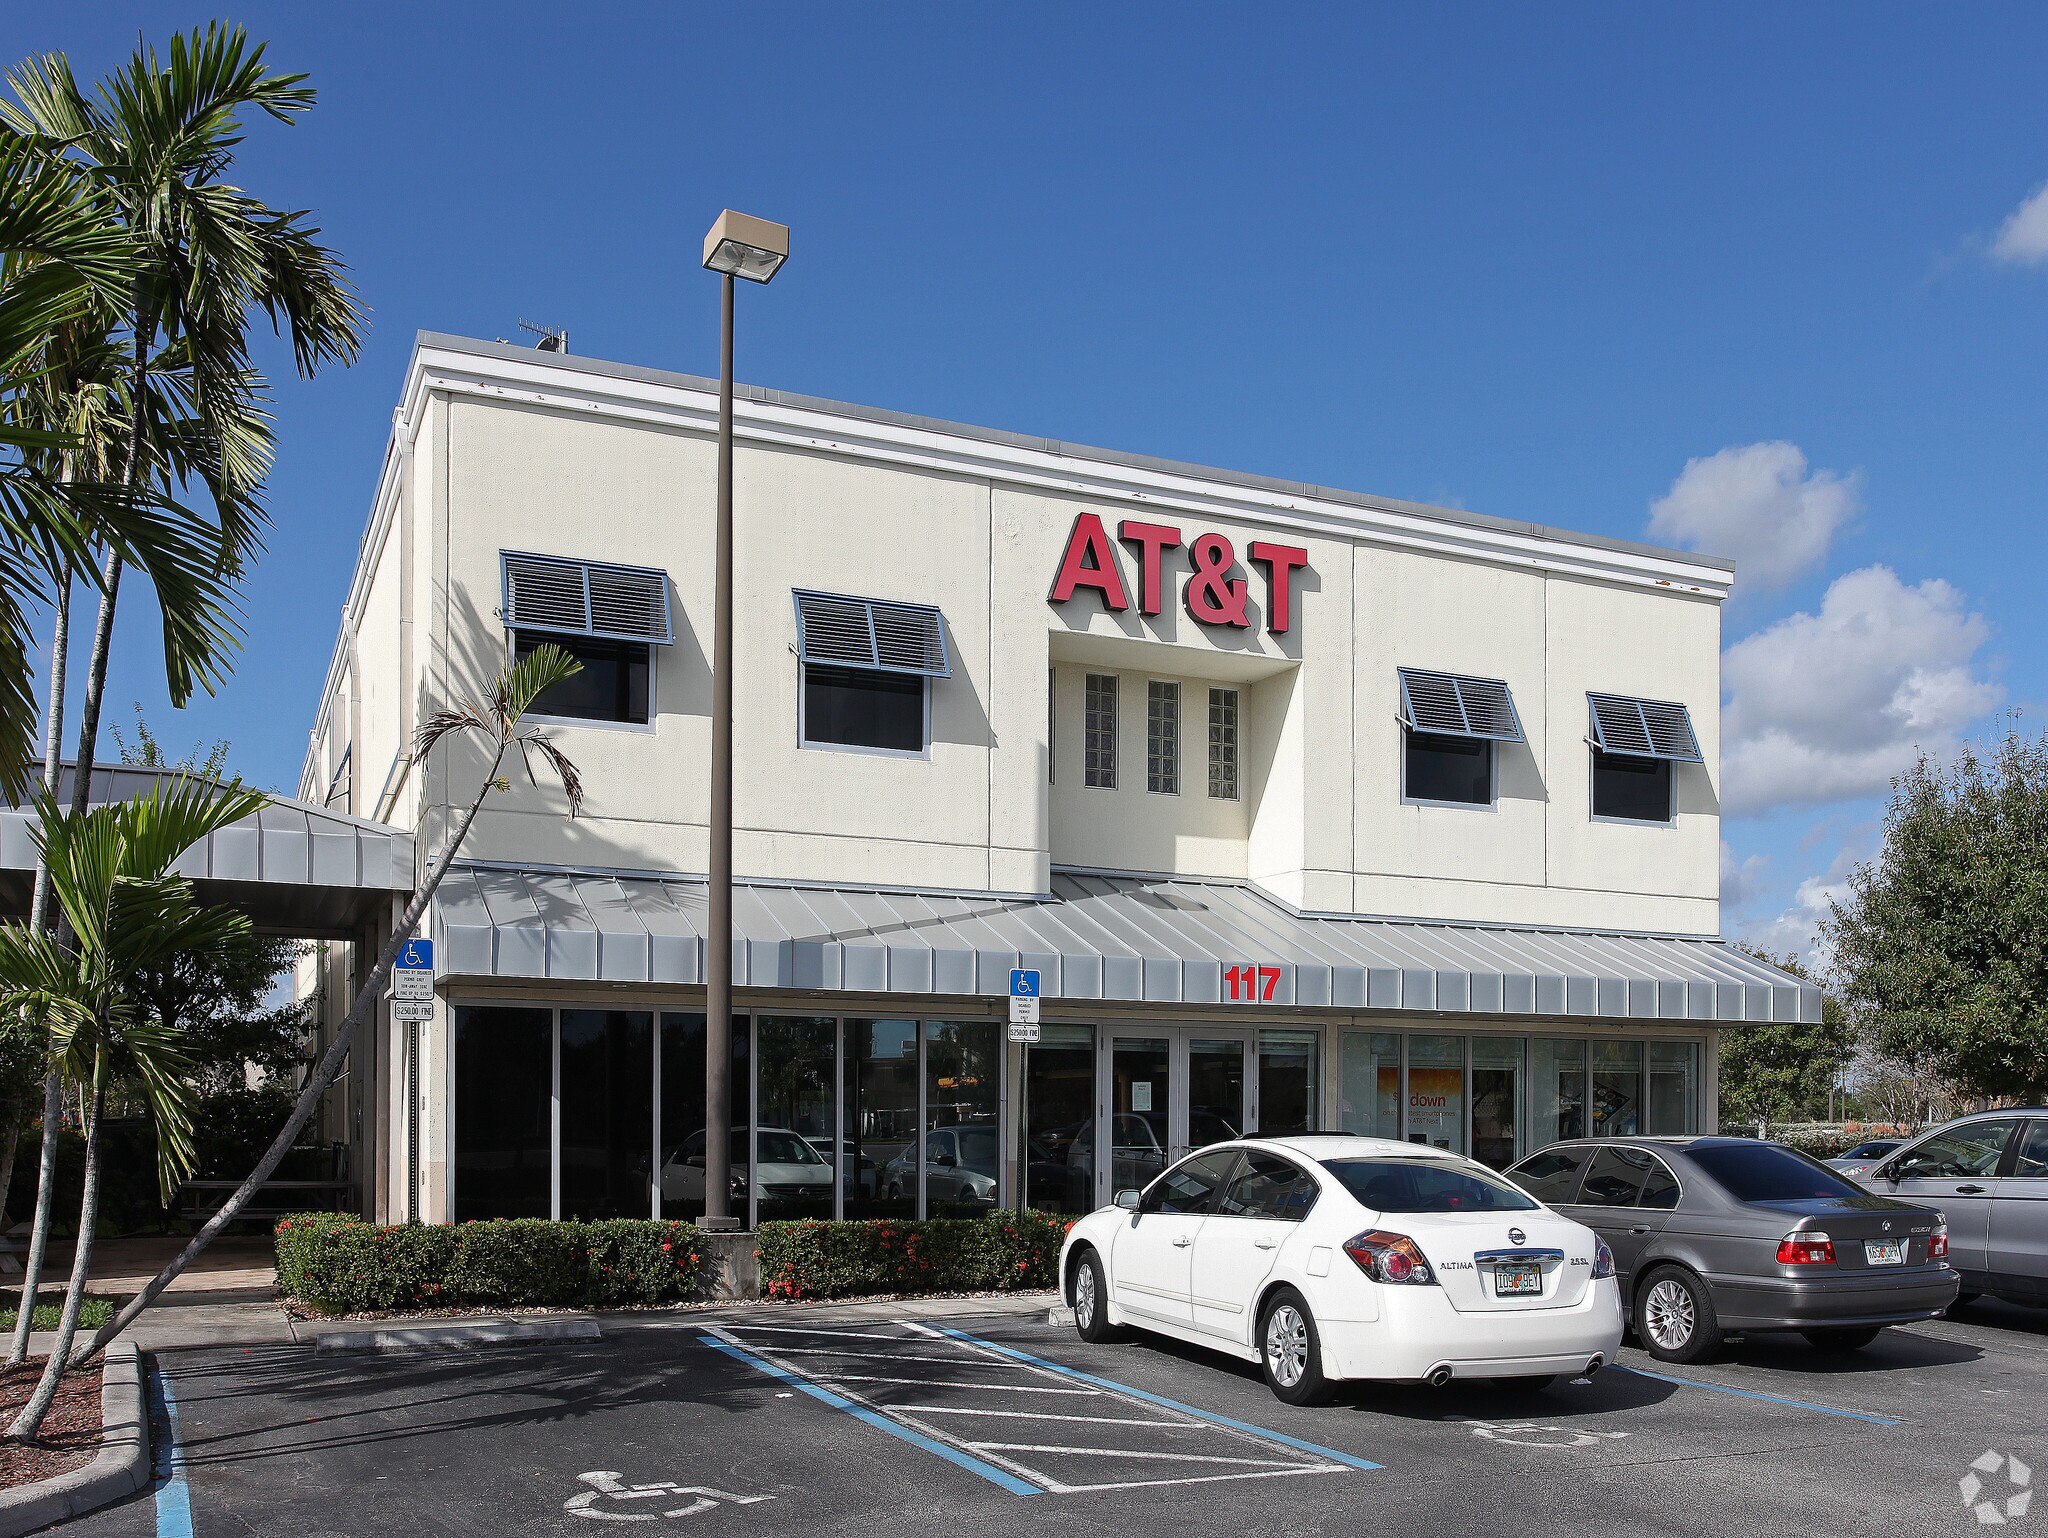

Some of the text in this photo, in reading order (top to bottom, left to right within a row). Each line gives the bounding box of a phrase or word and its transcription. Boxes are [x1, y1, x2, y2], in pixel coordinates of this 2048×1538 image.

[1048, 512, 1307, 634] AT&T
[1224, 965, 1281, 1001] 117
[397, 1006, 431, 1015] $250.00 FINE
[1410, 1091, 1446, 1107] down
[1440, 1261, 1474, 1270] ALTIMA
